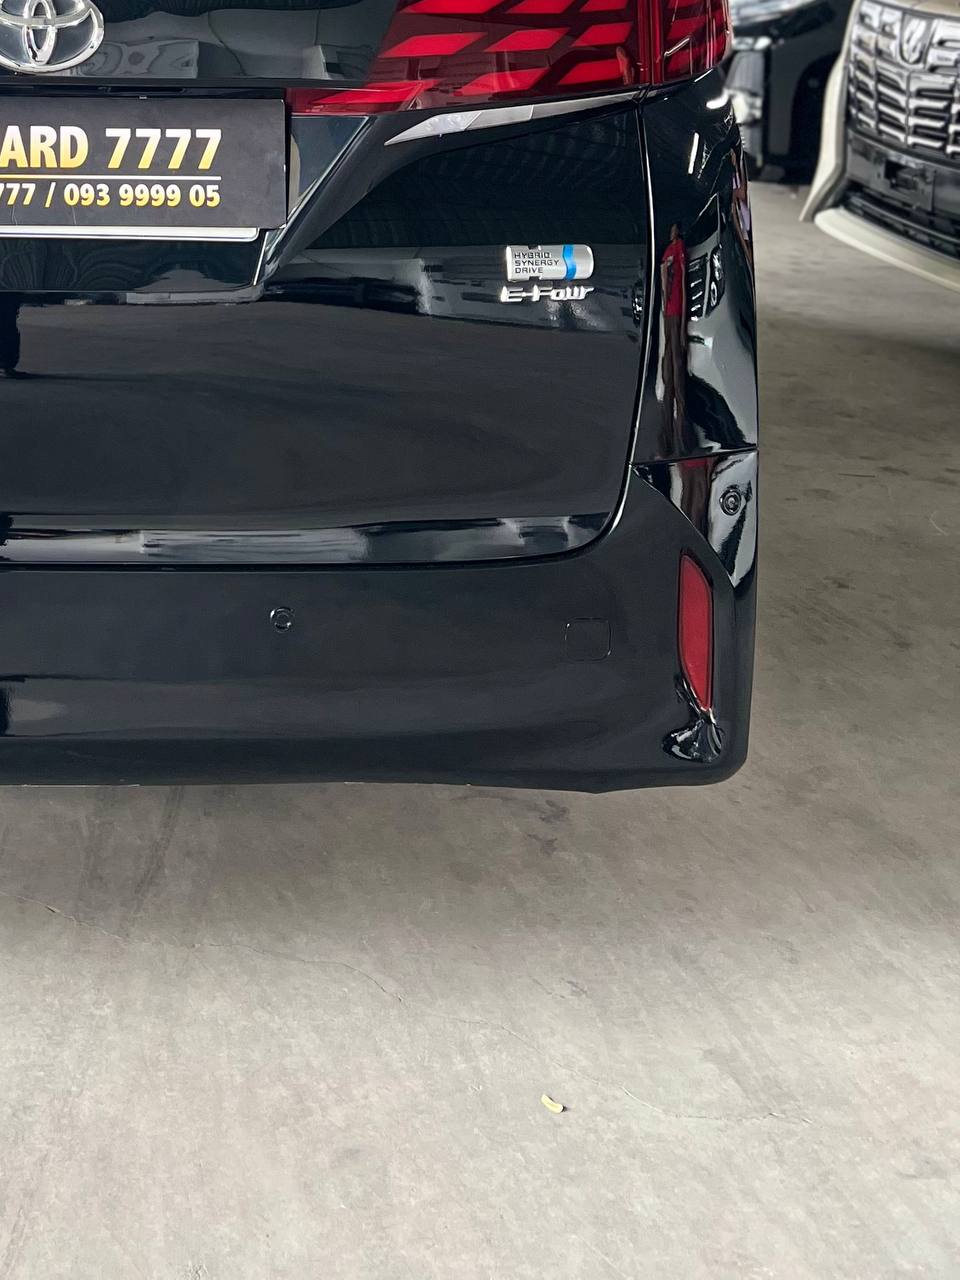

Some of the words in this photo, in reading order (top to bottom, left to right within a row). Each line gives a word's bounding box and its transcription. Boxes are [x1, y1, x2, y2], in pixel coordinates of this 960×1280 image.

[105, 127, 223, 170] 7777
[44, 181, 57, 209] /
[63, 183, 111, 207] 093
[119, 184, 182, 208] 9999
[189, 184, 222, 208] 05
[514, 259, 560, 267] SYNERGY
